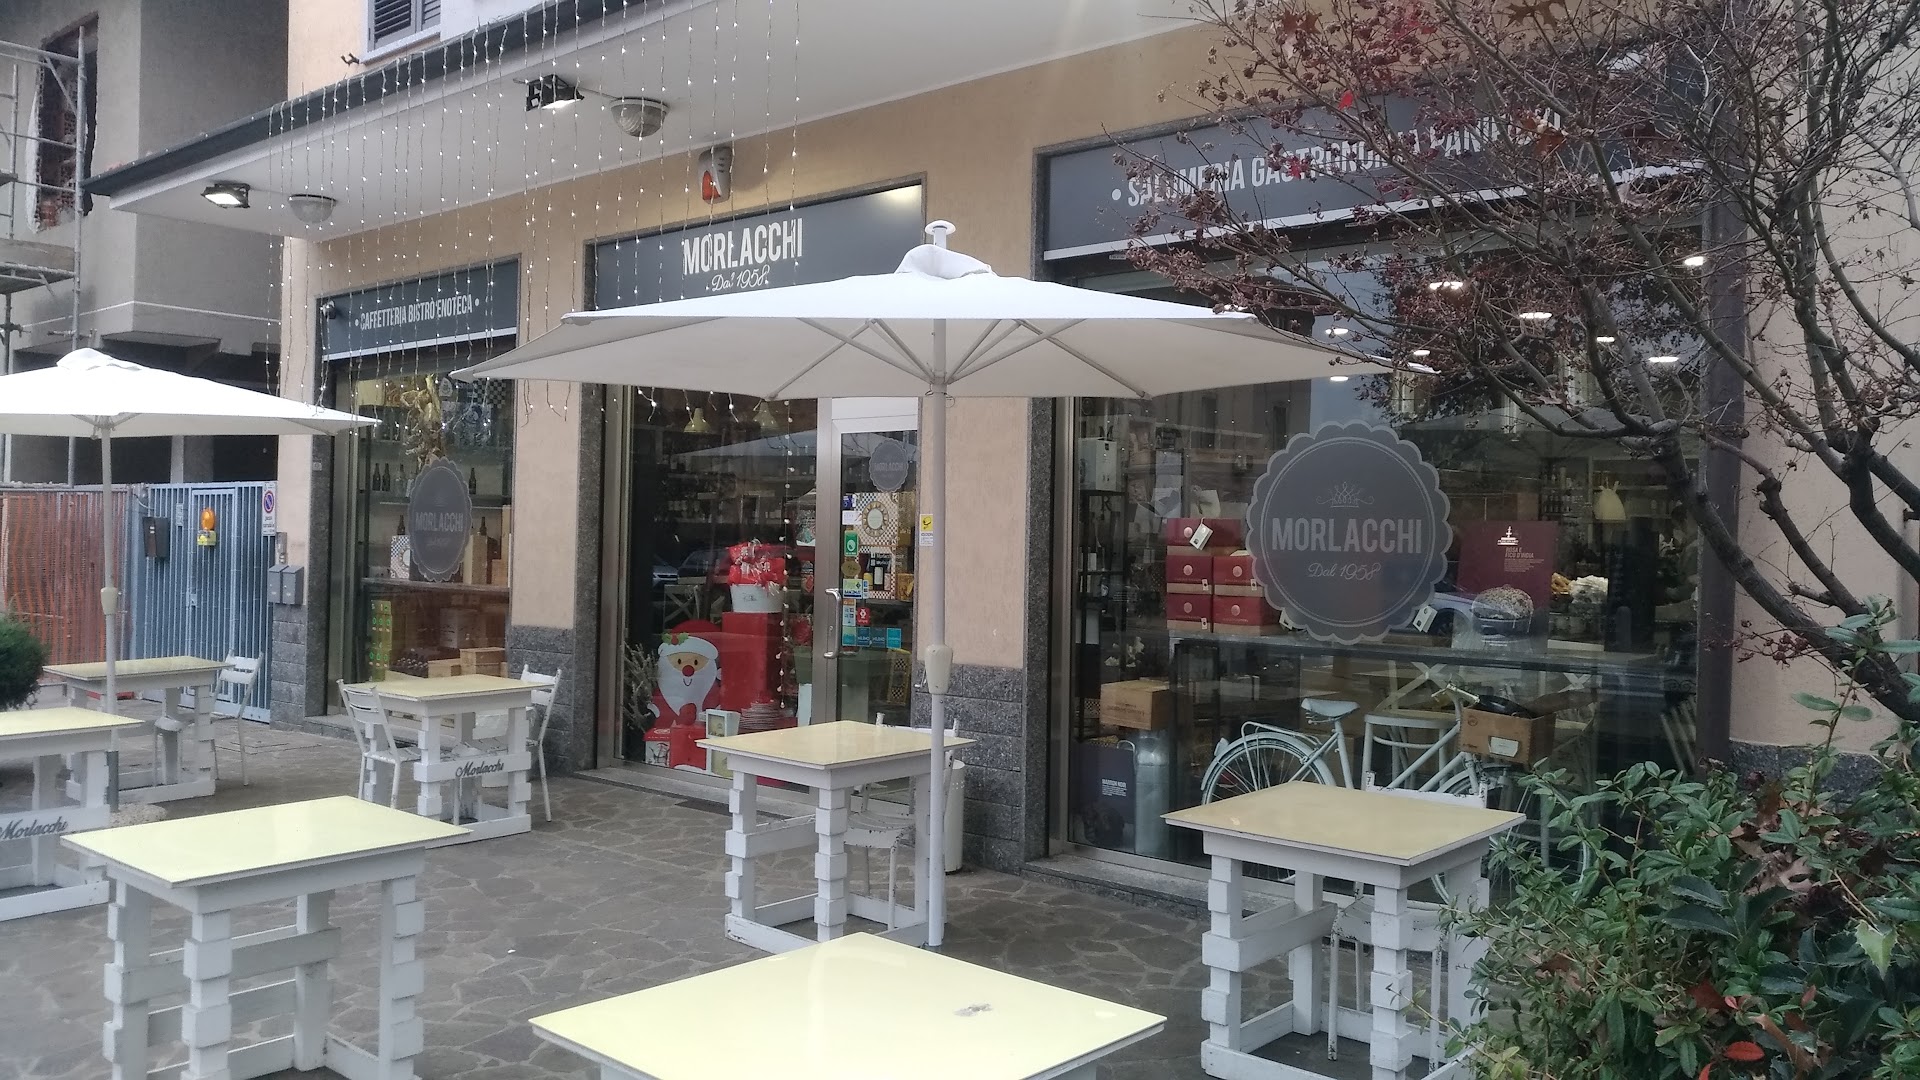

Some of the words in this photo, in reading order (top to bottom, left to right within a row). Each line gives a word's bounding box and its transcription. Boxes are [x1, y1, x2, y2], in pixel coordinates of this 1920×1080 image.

[1252, 127, 1422, 188] GASTRONOA
[683, 218, 803, 275] MORLACCHI
[711, 271, 735, 292] Dal
[736, 264, 771, 289] 1958
[360, 305, 407, 331] CAFFETTERIA
[408, 297, 435, 322] BISTRÒ
[436, 294, 473, 317] ENOTECA
[415, 512, 464, 533] MORLACCHI
[1272, 517, 1422, 554] MORLACCHI
[1308, 562, 1338, 578] Dal
[1340, 562, 1381, 581] 1958
[455, 759, 504, 777] Morlacchi
[0, 816, 68, 840] Morlacchi
